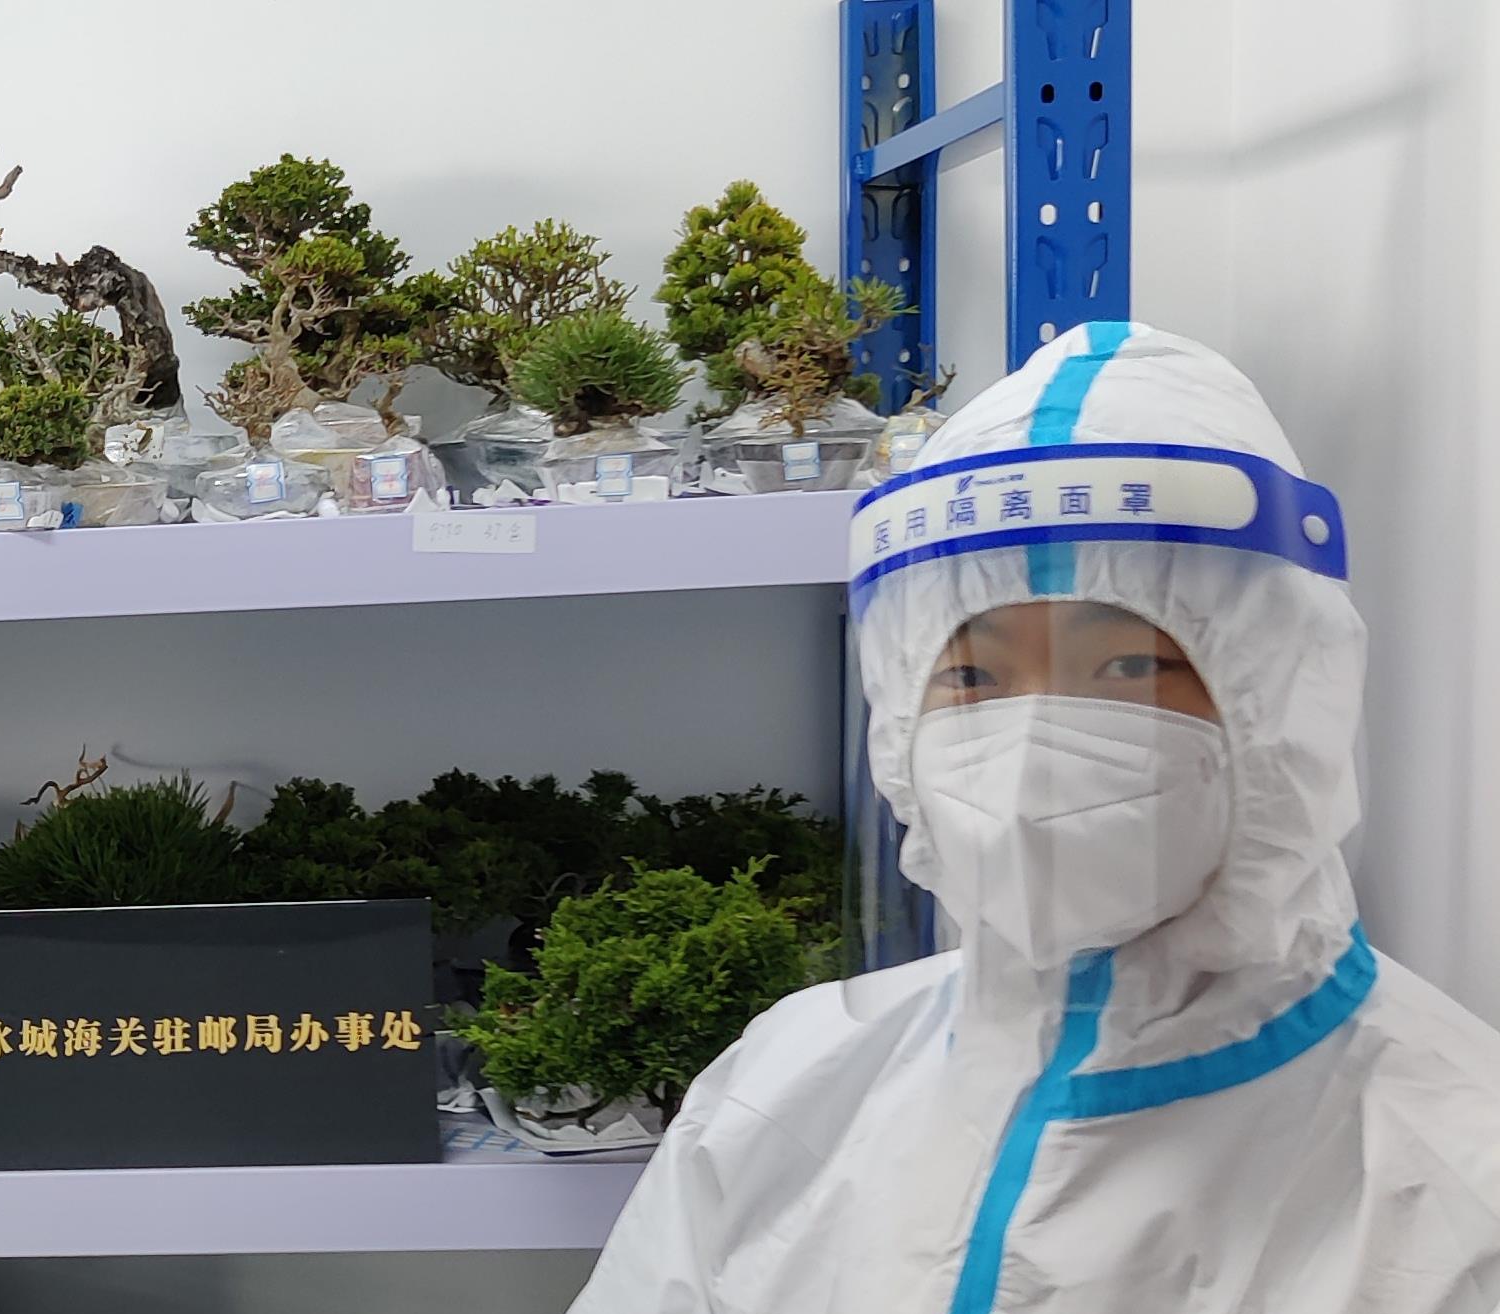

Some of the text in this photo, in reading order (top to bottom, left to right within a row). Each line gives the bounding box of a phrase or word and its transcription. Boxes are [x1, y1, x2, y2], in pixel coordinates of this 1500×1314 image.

[873, 484, 1153, 554] 医用隔离面罩
